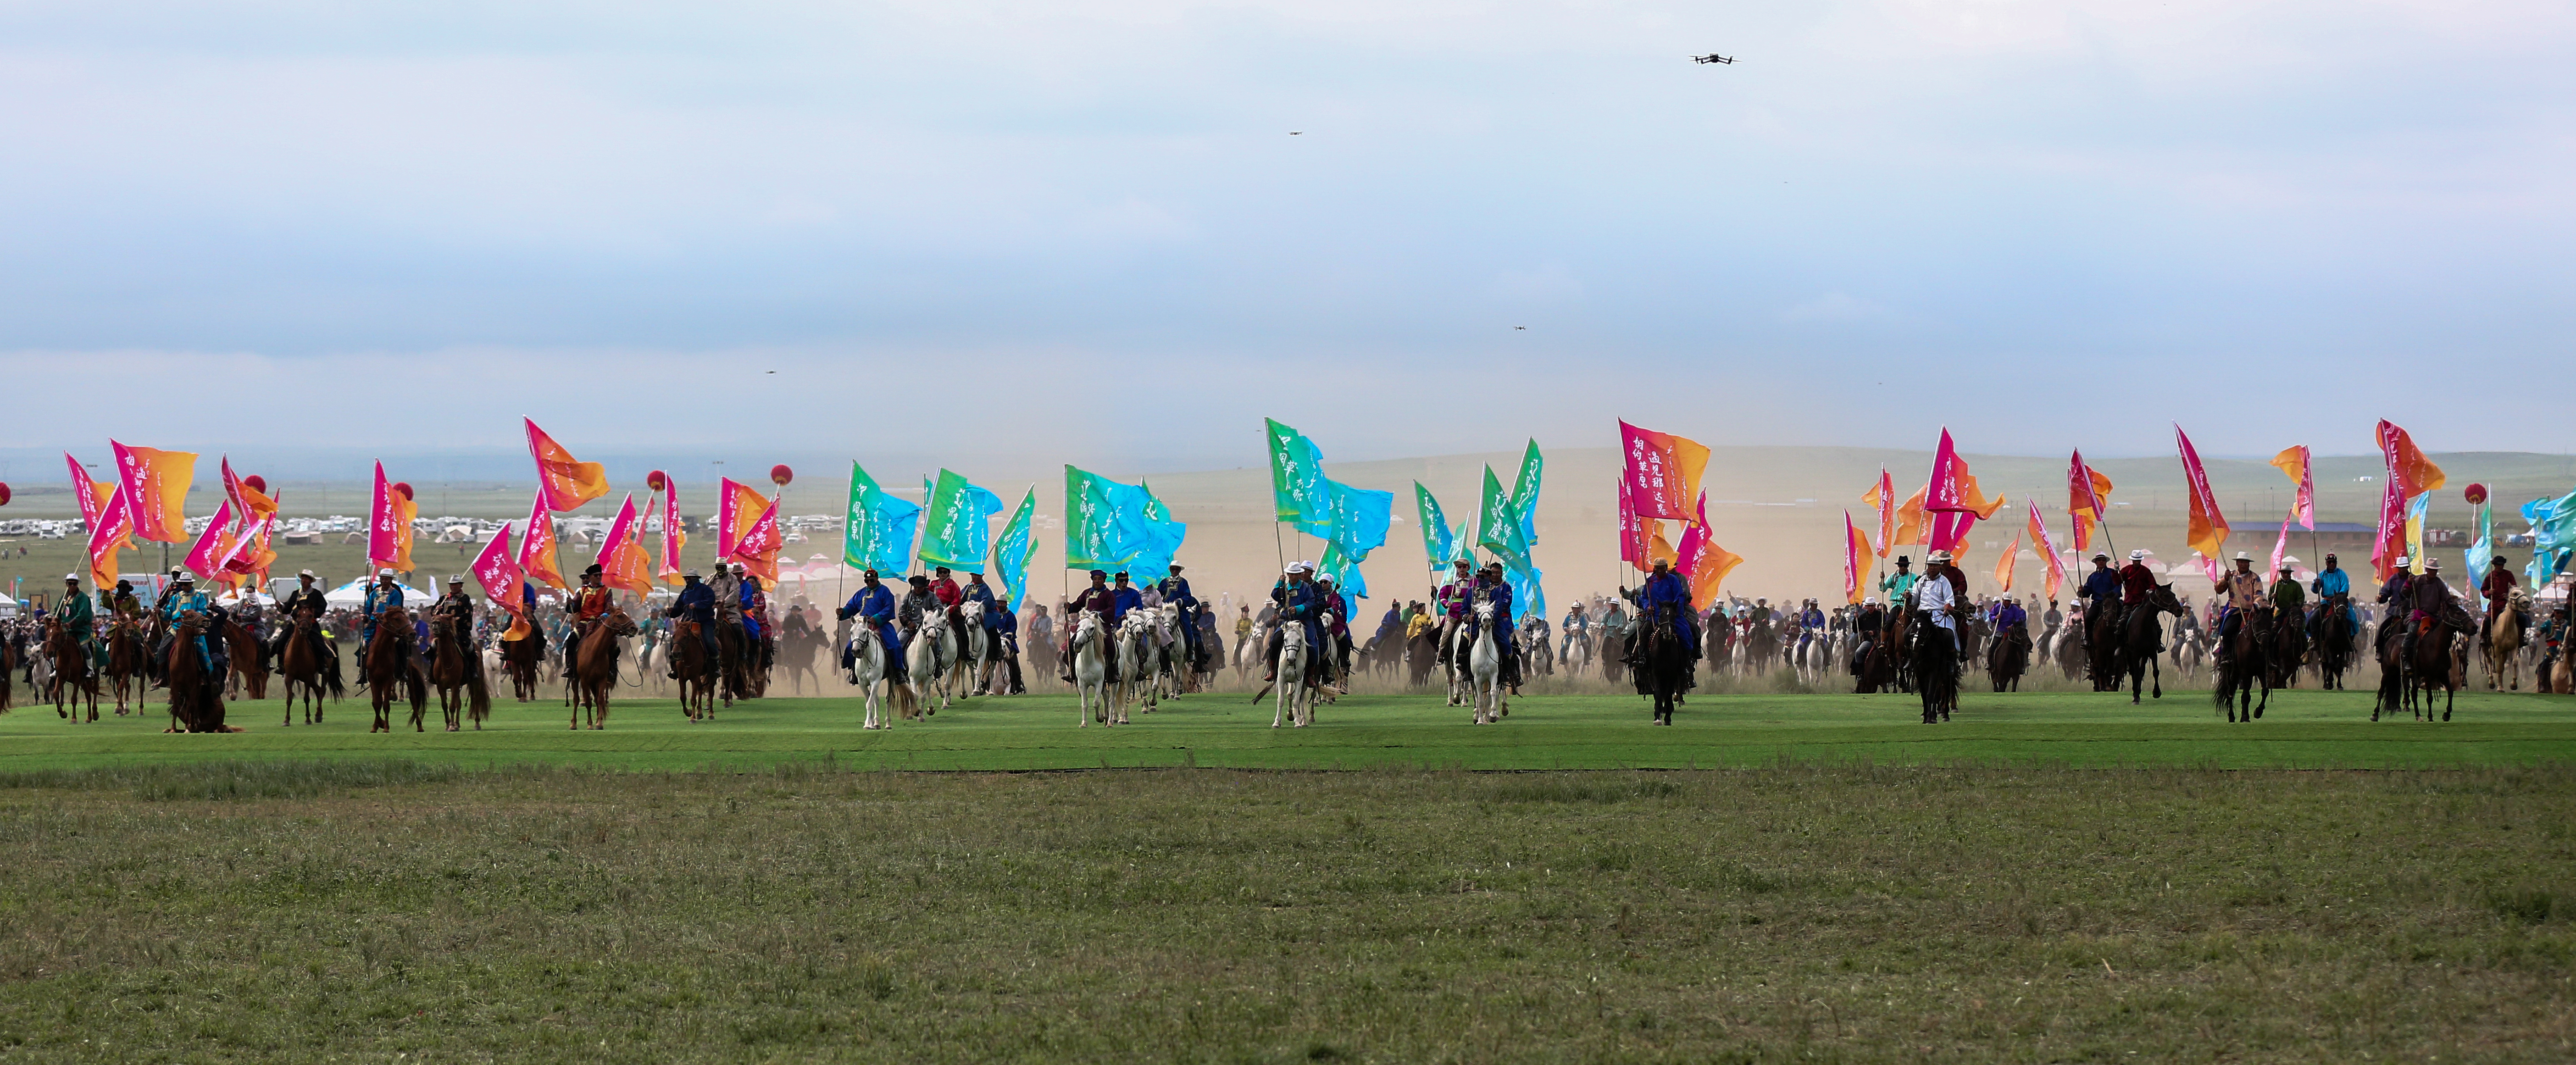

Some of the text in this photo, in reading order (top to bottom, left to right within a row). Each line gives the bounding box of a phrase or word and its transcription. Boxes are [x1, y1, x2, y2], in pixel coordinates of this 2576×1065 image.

[1632, 436, 1649, 489] 相约草原
[1648, 450, 1669, 516] 遇见那达慕
